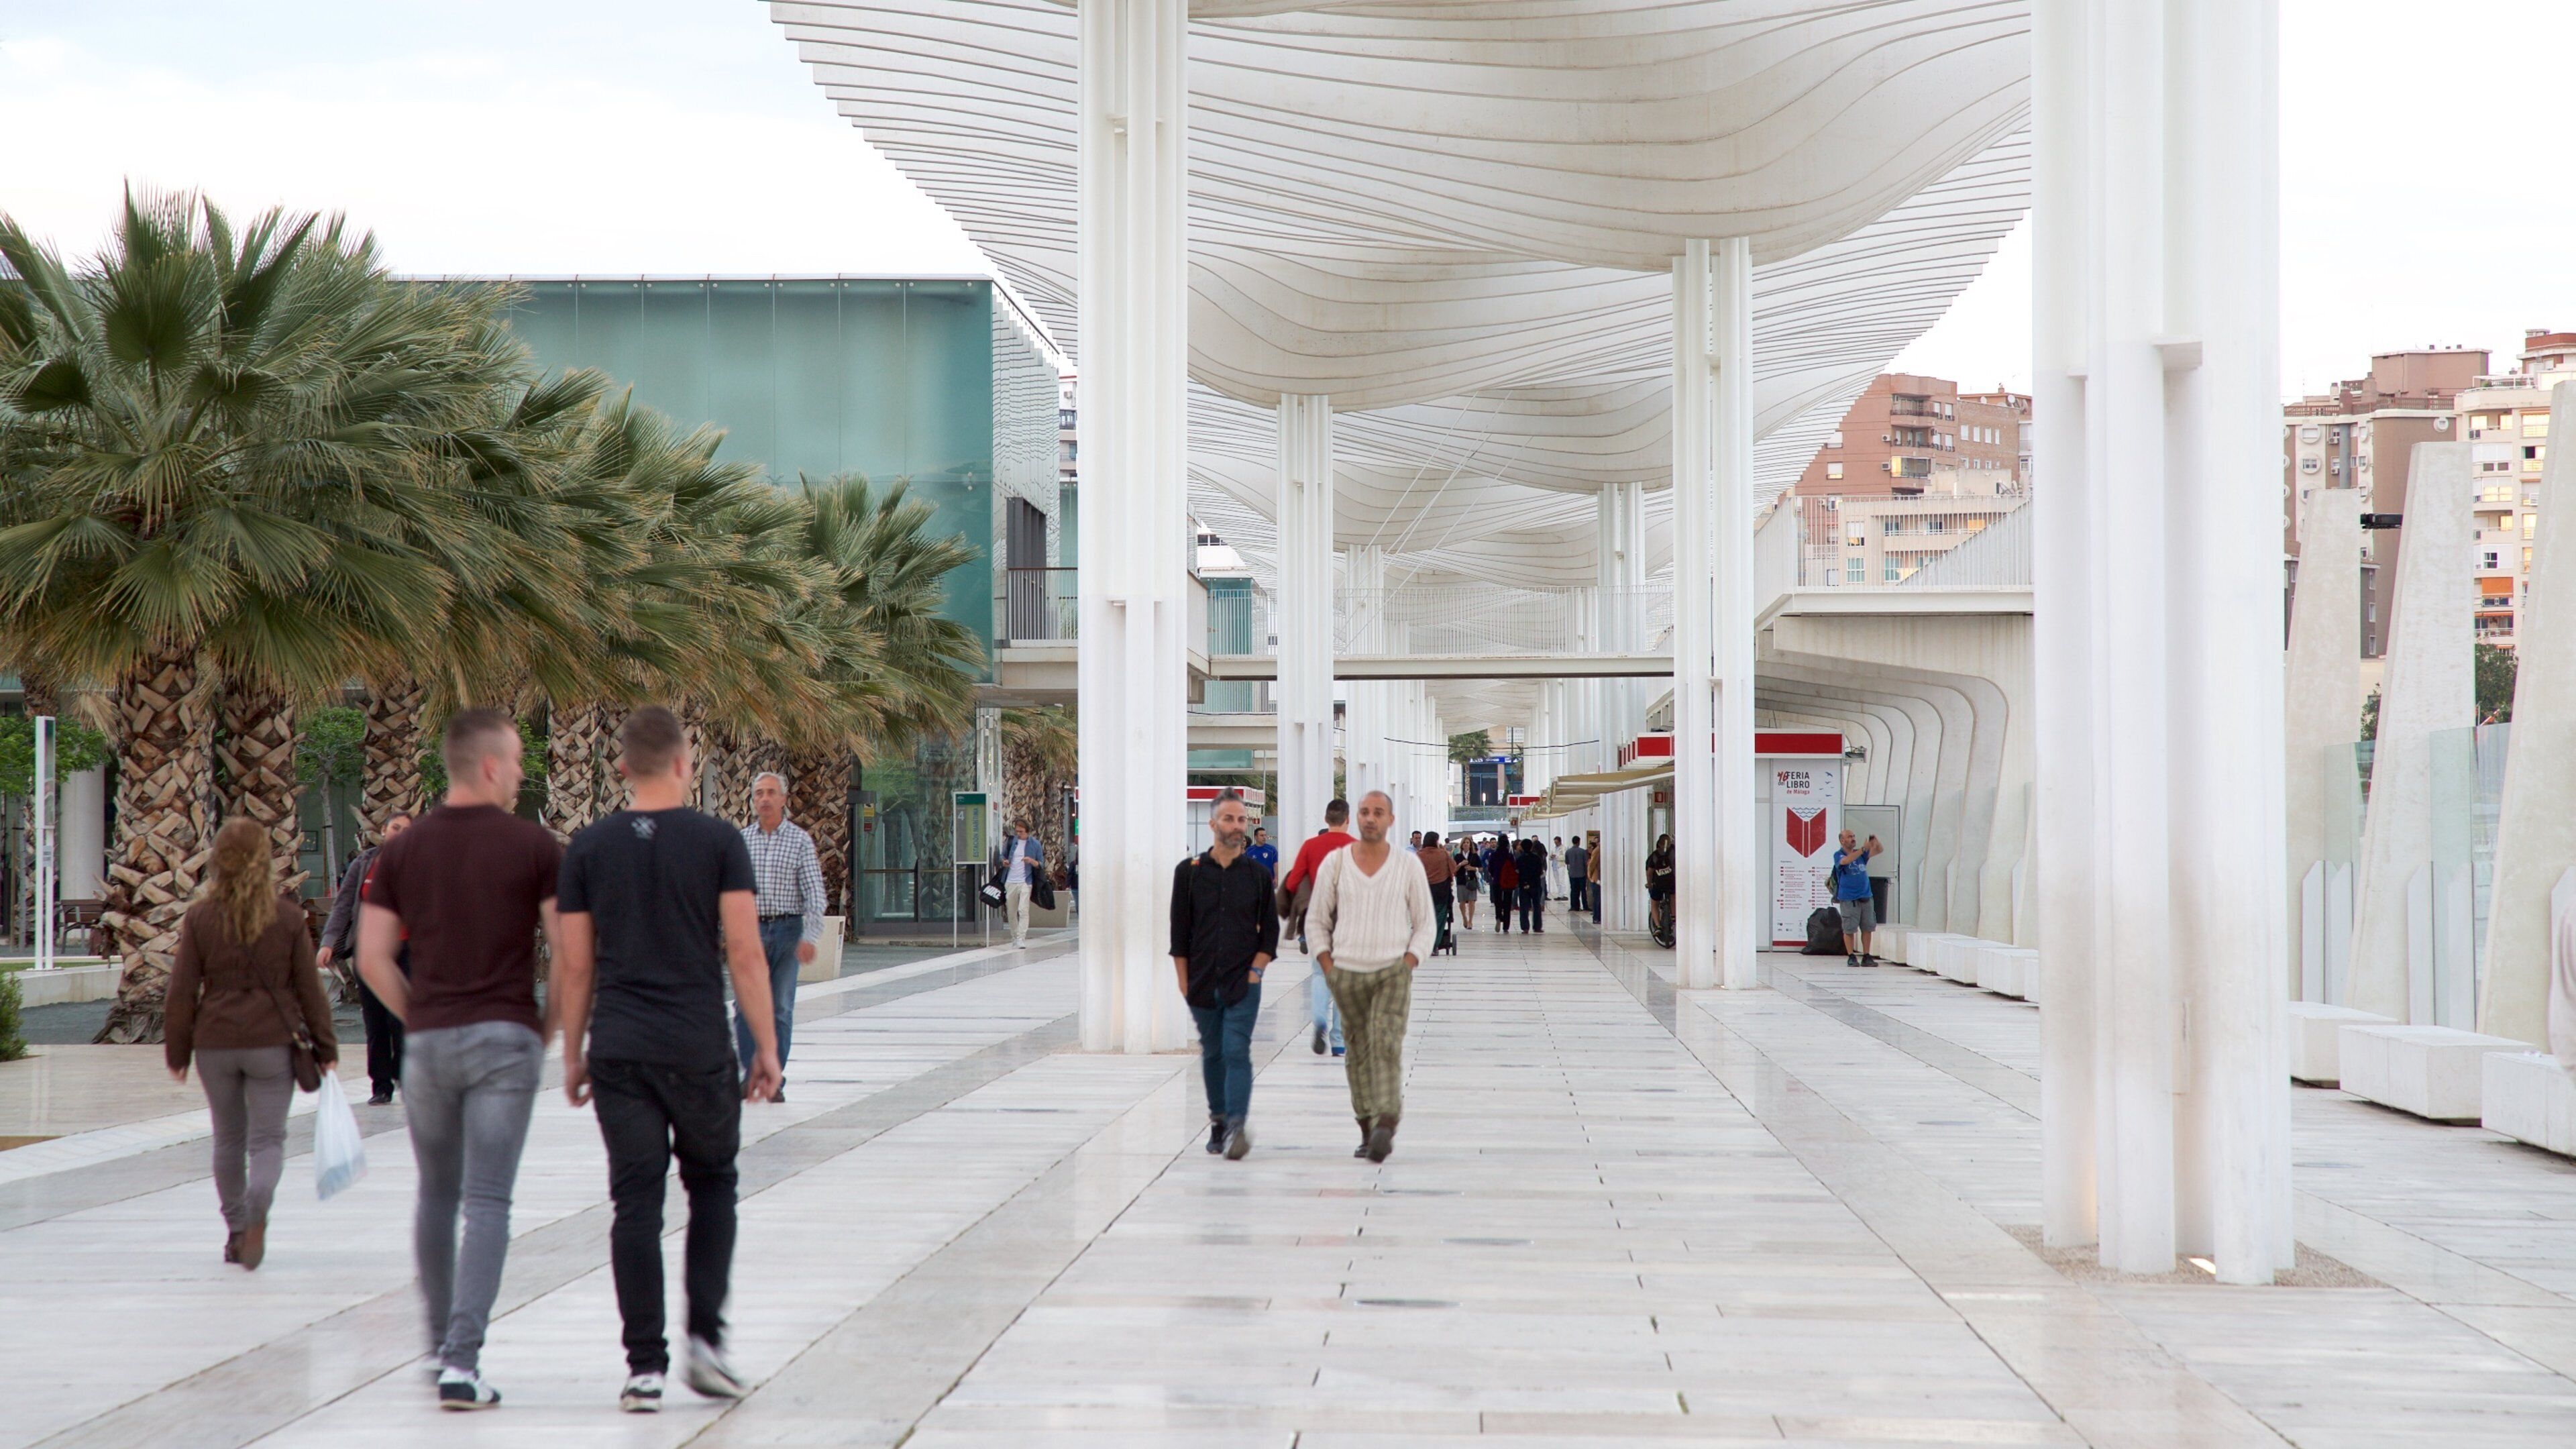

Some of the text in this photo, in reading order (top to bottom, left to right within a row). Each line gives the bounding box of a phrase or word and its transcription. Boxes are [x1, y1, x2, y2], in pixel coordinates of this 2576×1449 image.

[1786, 771, 1810, 780] FERIA
[1786, 780, 1810, 789] LIBRO
[957, 810, 965, 821] 4
[983, 885, 1002, 900] NIKE
